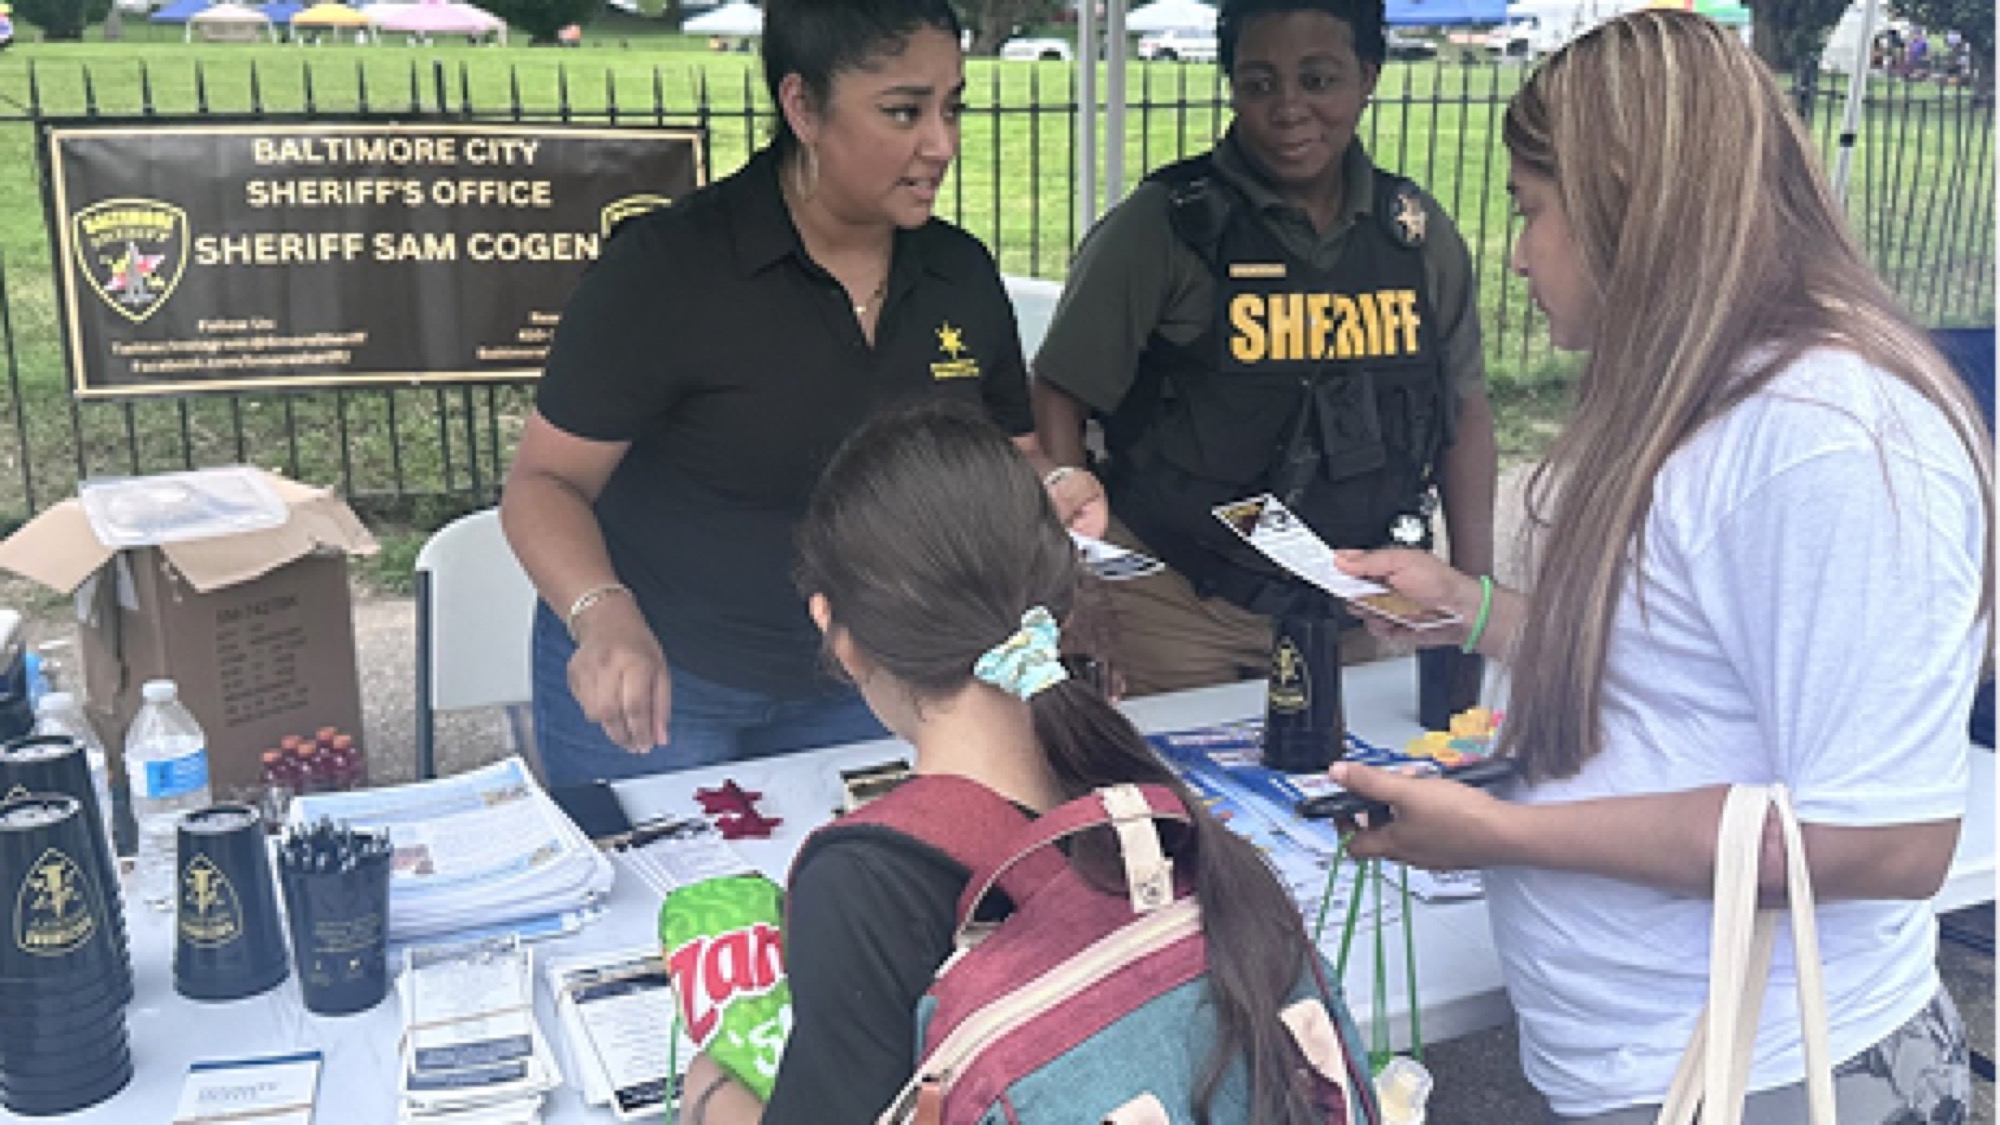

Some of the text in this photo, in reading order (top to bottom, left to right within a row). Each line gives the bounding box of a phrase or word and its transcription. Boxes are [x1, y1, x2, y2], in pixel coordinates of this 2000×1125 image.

[253, 138, 539, 165] BALTIMORE CITY
[246, 178, 552, 208] SHERIFF'S OFFICE
[194, 231, 600, 267] SHERIFF SAM COGEN
[1230, 289, 1421, 365] SHERIFF
